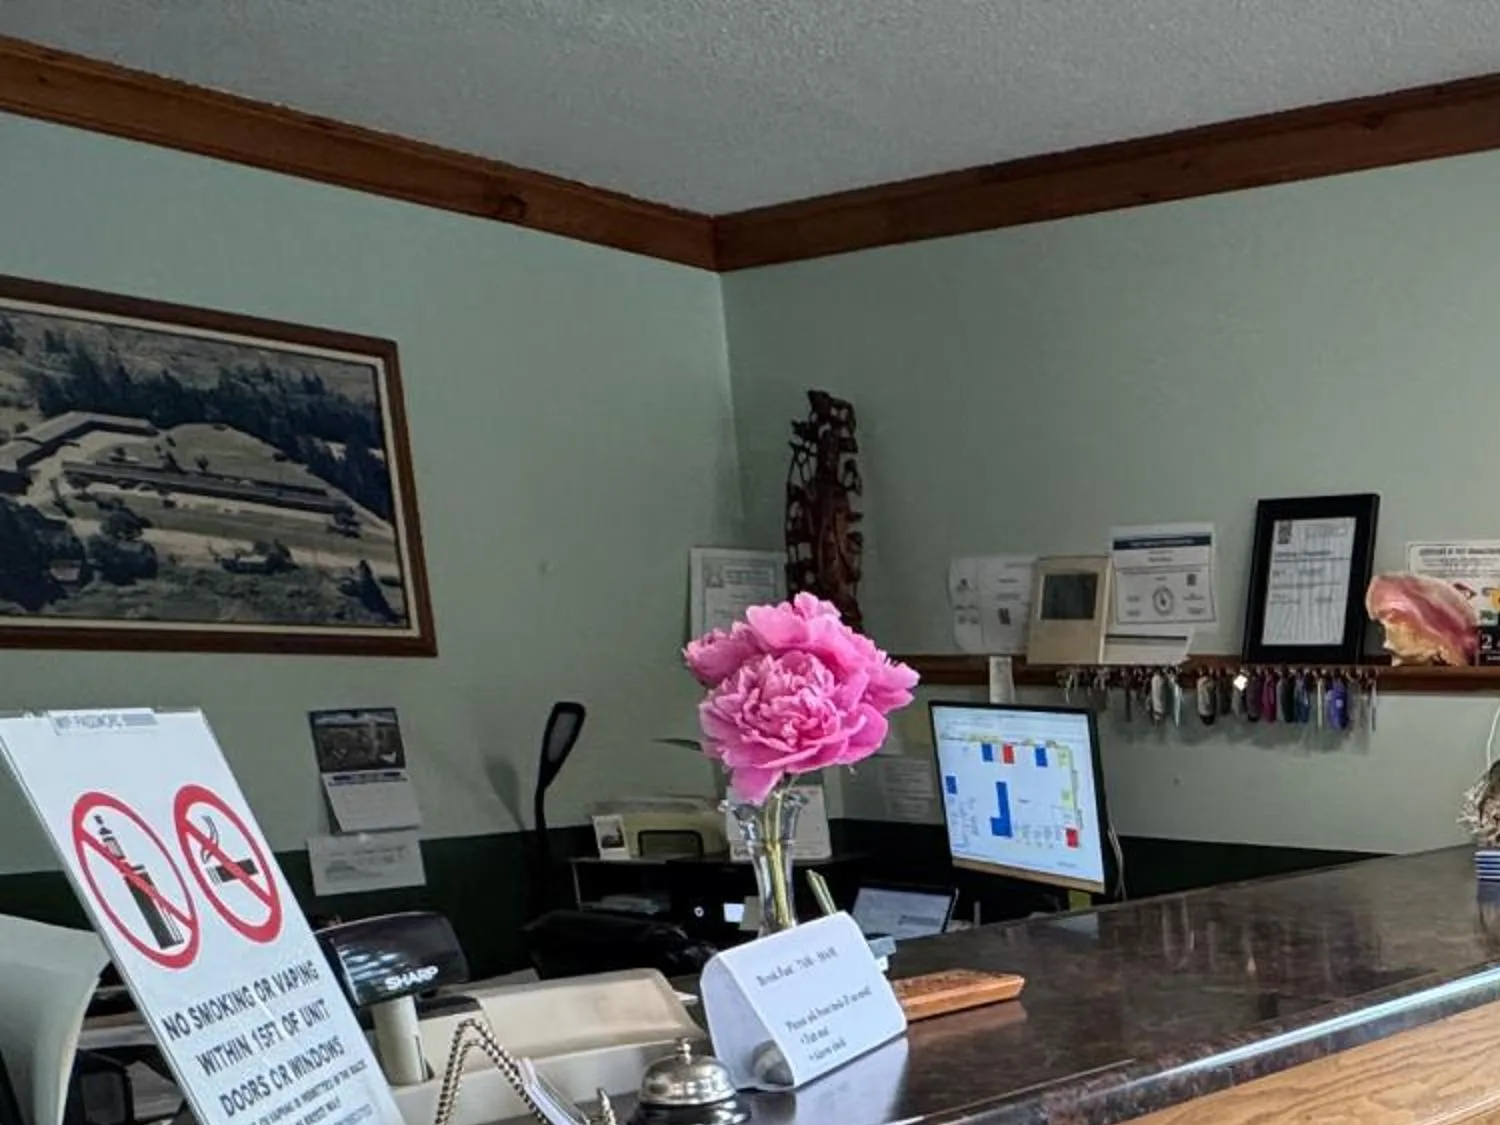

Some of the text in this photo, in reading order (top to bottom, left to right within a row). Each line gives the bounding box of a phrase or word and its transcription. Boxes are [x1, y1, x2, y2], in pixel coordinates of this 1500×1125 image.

[162, 960, 320, 1041] NO SMOKING OR VAPING
[384, 965, 439, 990] SHARP
[196, 998, 331, 1076] WITHIN 15FT OF UNIT
[219, 1074, 271, 1117] DOORS
[269, 1064, 294, 1090] OR
[287, 1035, 345, 1079] WINDOWS
